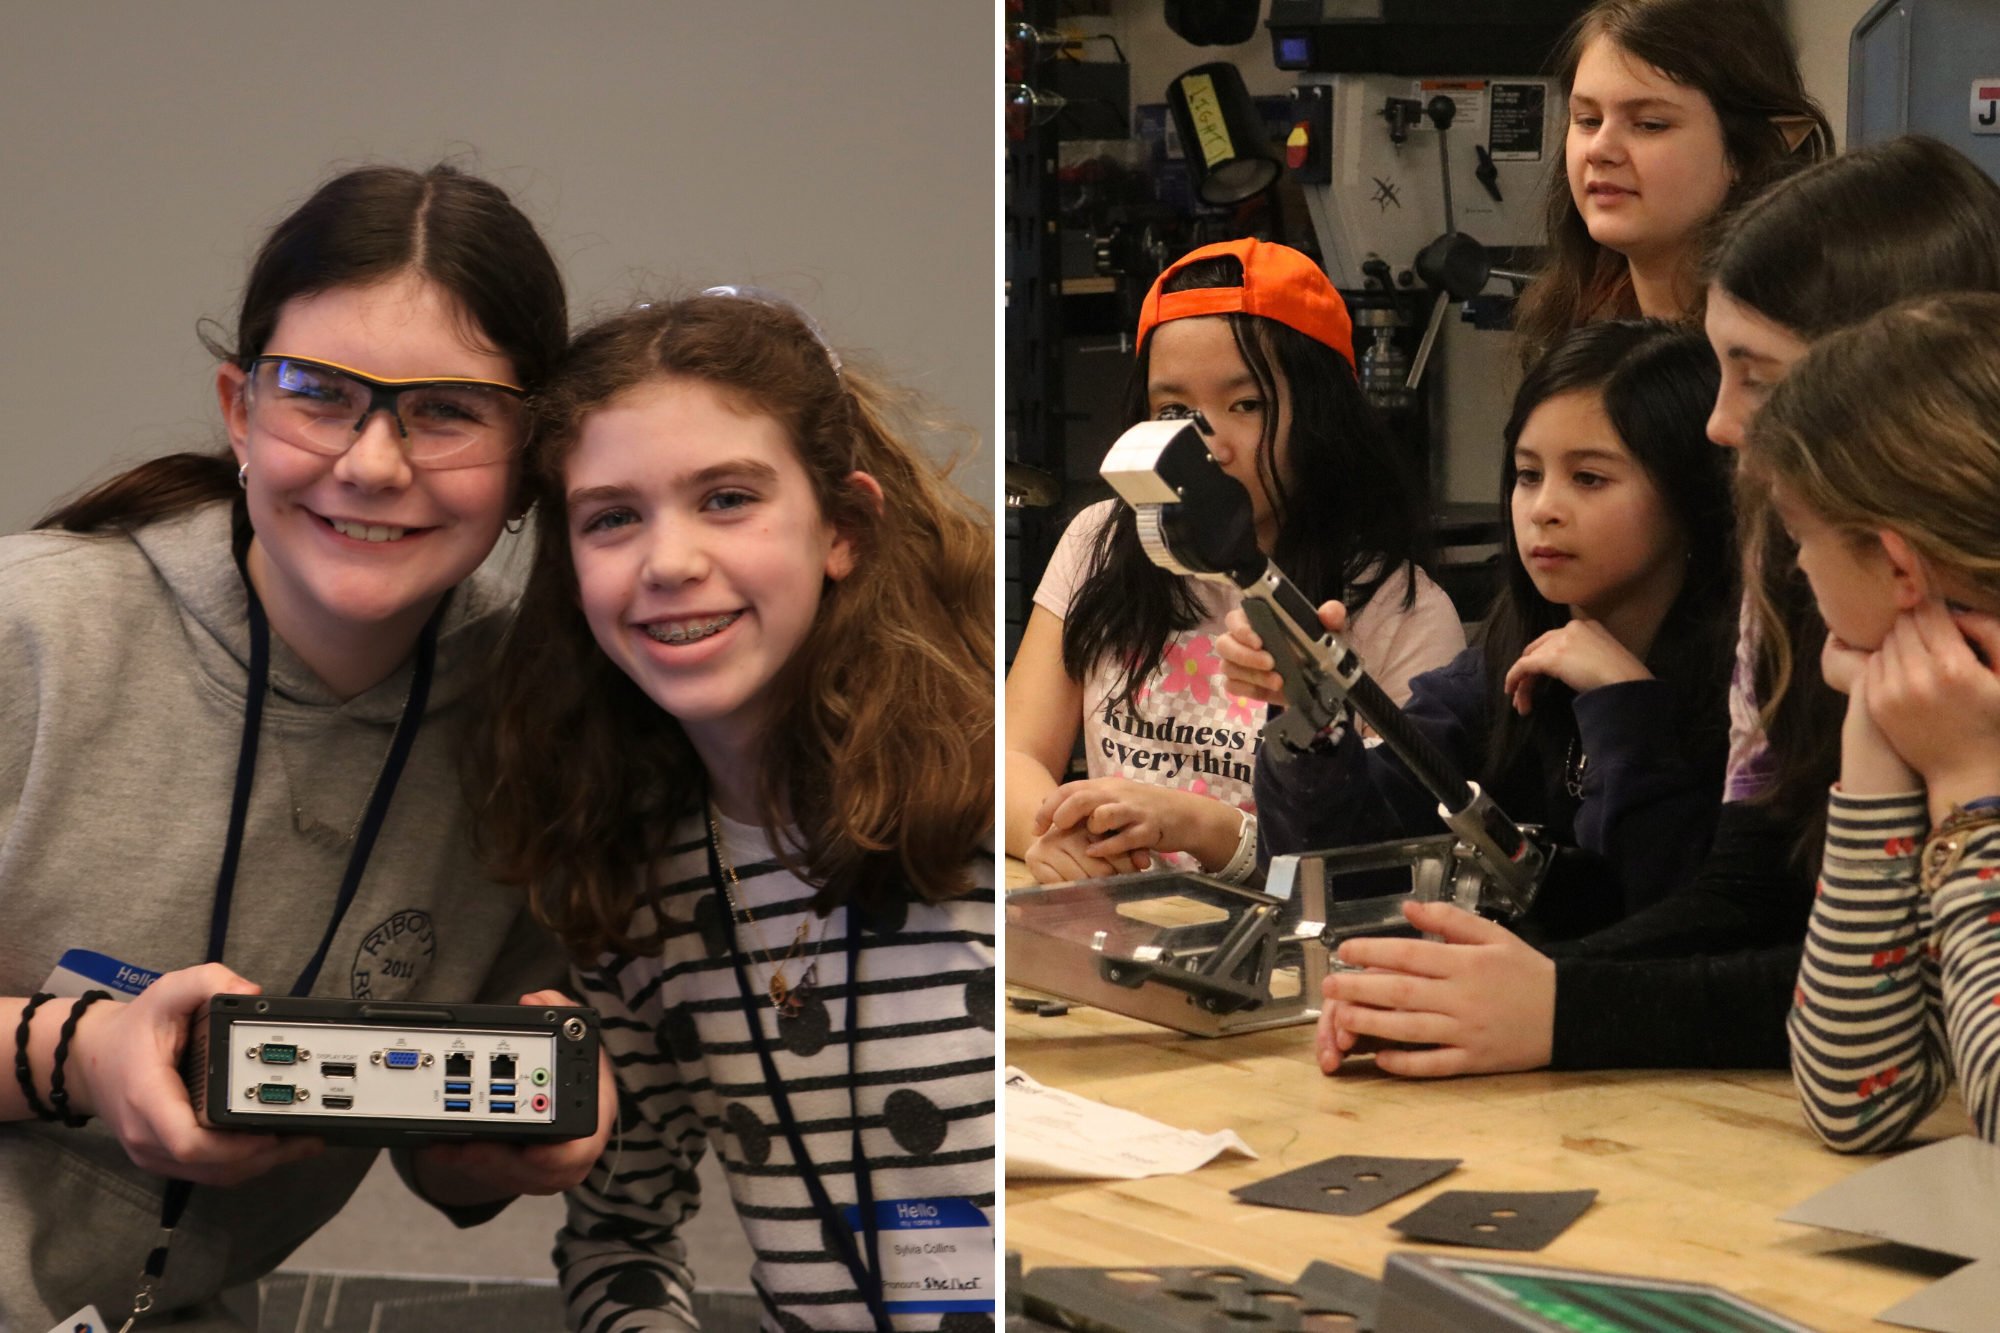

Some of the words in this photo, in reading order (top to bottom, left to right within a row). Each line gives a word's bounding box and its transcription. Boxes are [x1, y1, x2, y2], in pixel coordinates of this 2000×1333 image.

[1101, 737, 1252, 785] everythin
[380, 959, 415, 979] 2011
[896, 1202, 938, 1219] Hello
[894, 1244, 921, 1256] Sylvia
[924, 1243, 956, 1254] Collins
